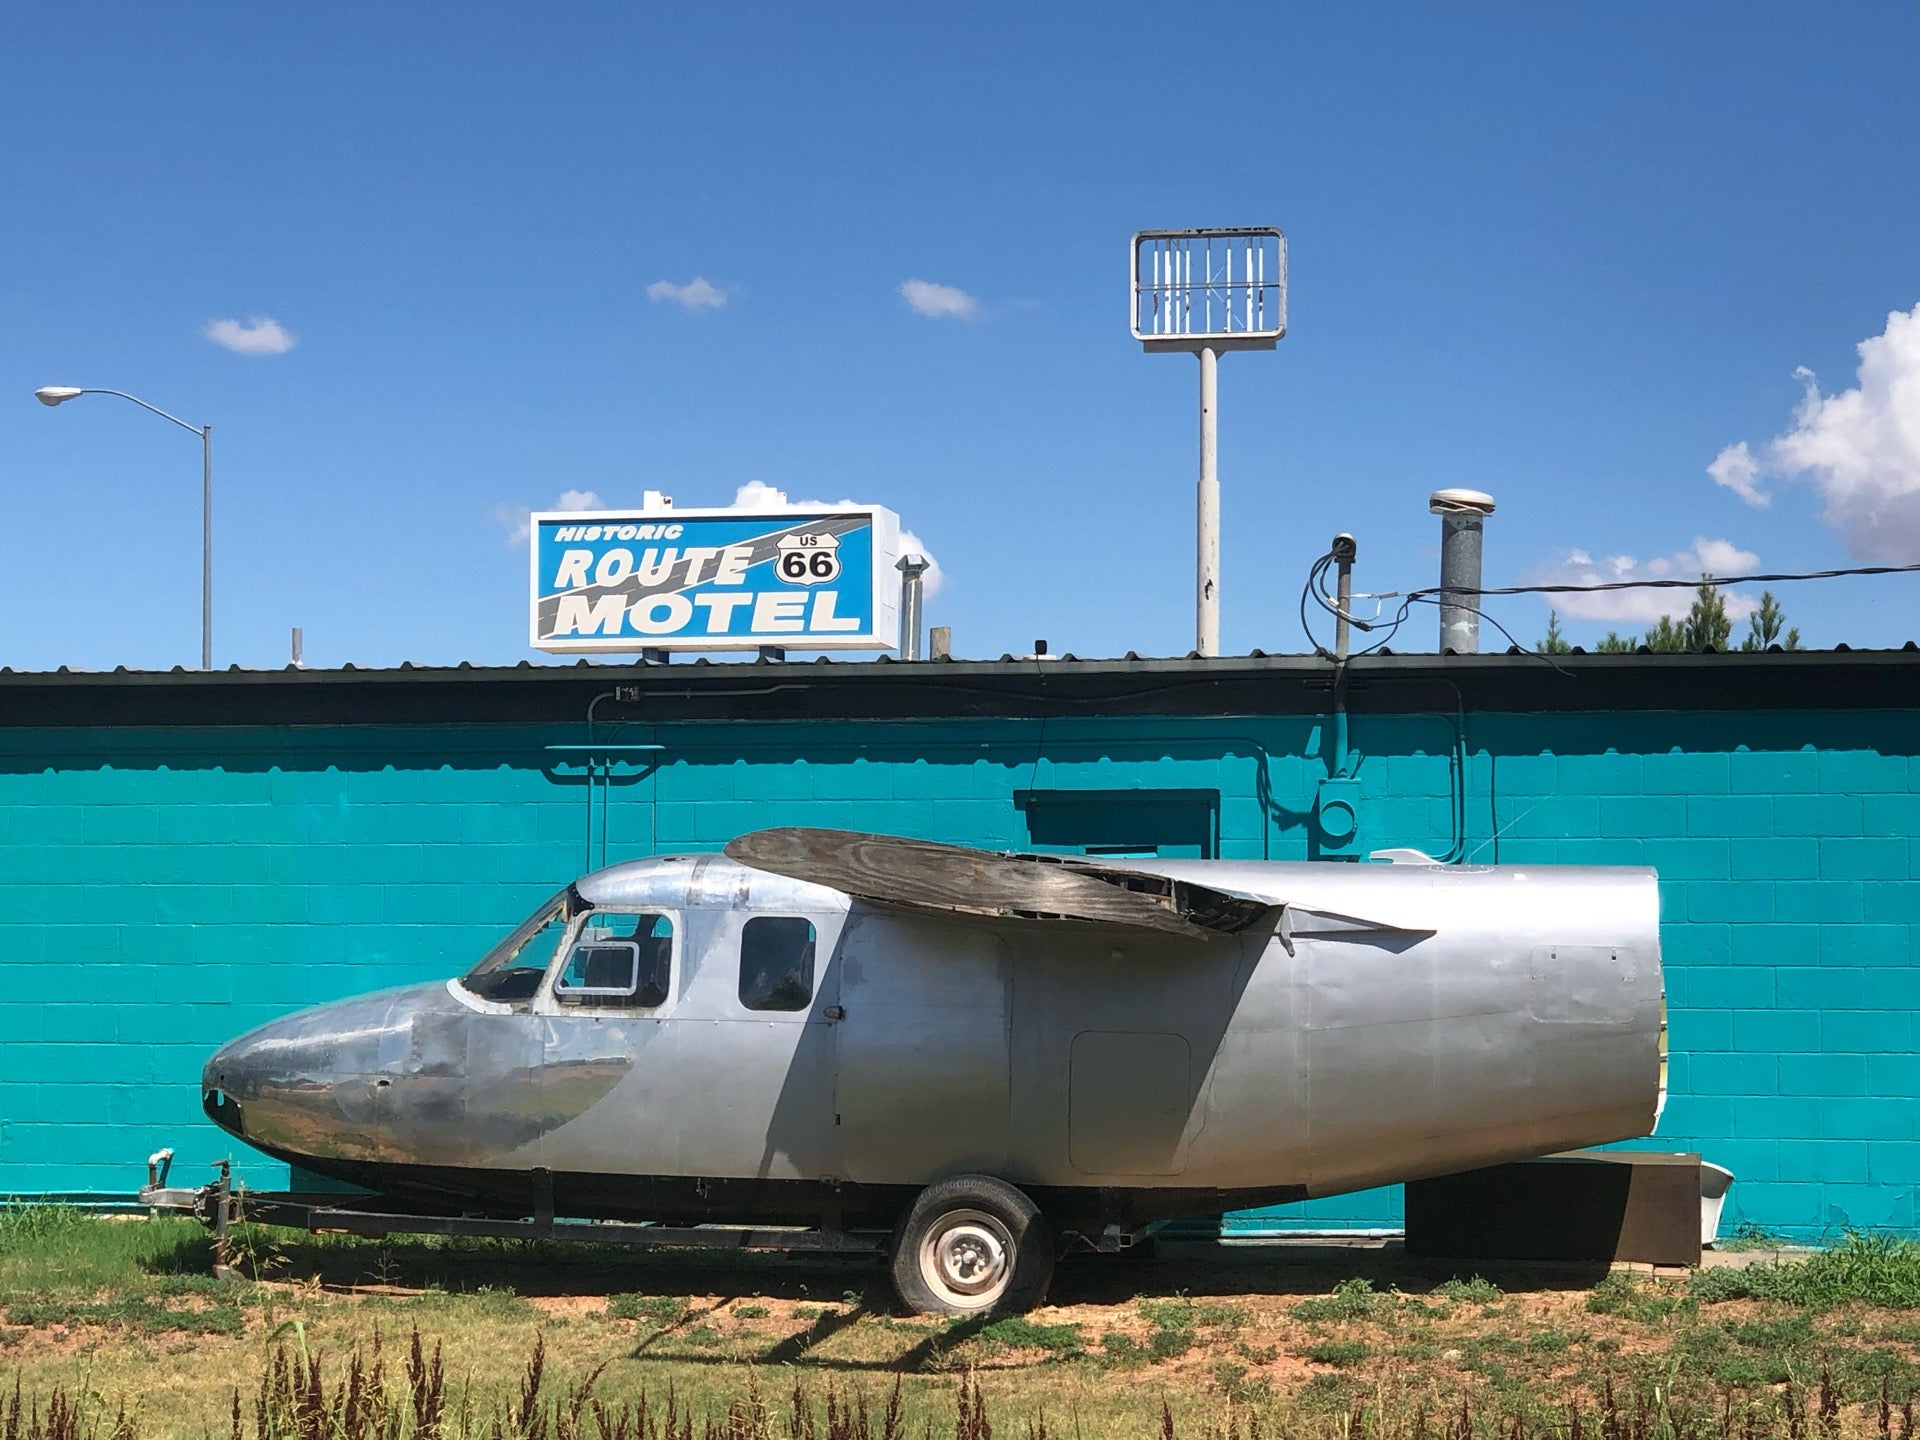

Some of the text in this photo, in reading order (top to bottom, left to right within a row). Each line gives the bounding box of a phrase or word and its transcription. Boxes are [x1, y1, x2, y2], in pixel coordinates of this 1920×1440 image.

[554, 525, 684, 542] HISTORIC
[799, 536, 818, 547] US
[554, 547, 754, 588] ROUTE
[782, 551, 833, 578] 66
[553, 590, 861, 635] MOTEL
